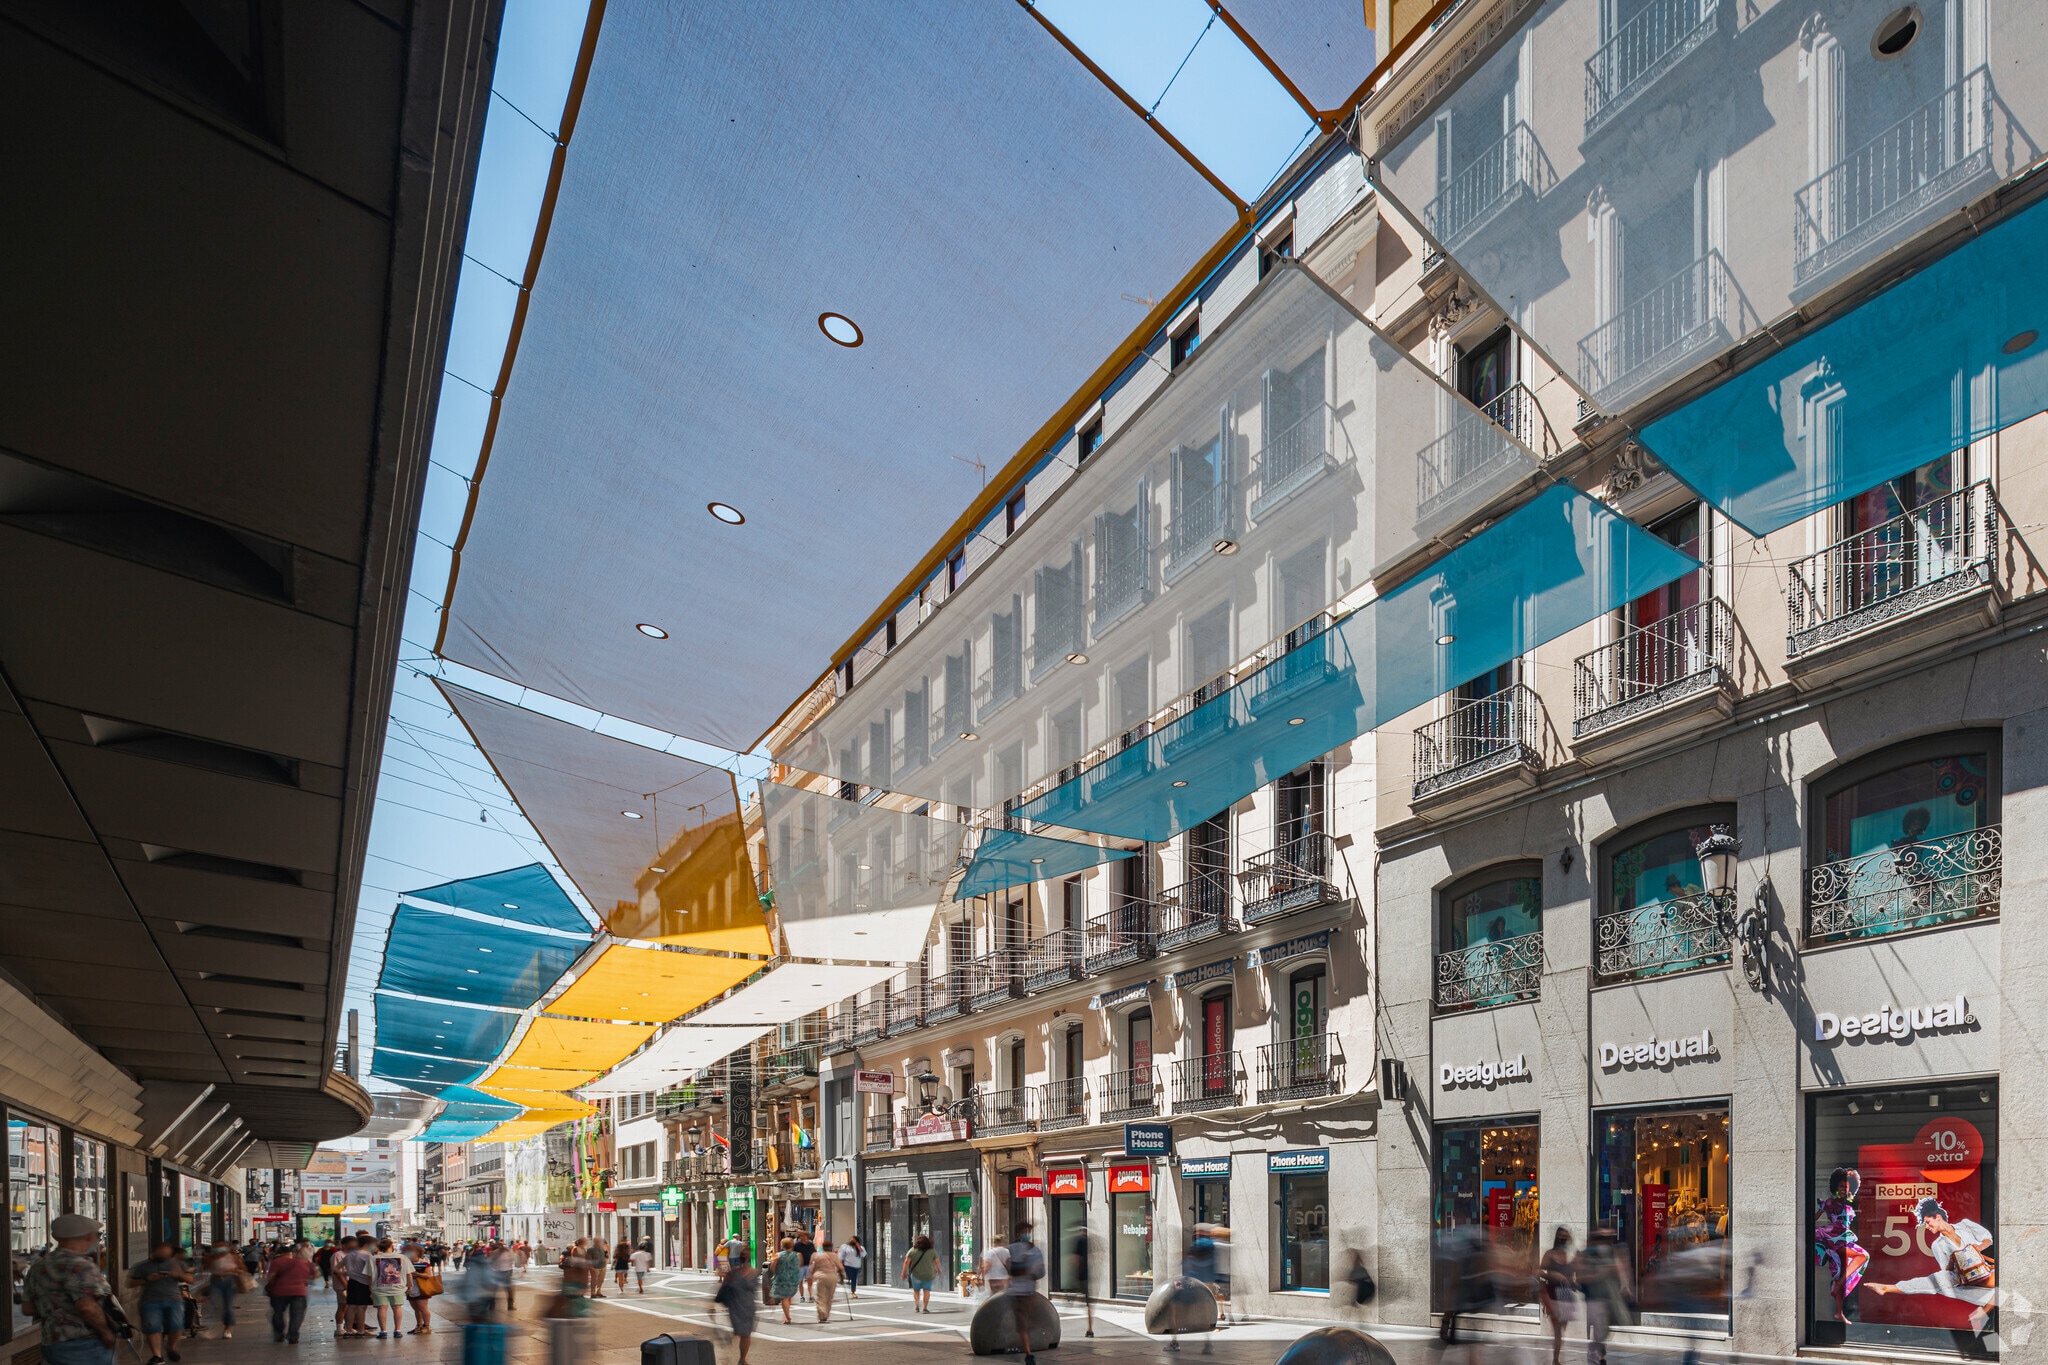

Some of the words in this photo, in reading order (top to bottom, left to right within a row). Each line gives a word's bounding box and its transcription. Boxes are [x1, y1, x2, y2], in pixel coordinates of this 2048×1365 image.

[1250, 946, 1287, 967] Phone
[1167, 971, 1197, 988] Phone
[1198, 962, 1231, 980] House
[1131, 1130, 1164, 1139] Phone
[1924, 1130, 1966, 1151] -10%
[1131, 1139, 1164, 1148] House
[1181, 1163, 1204, 1173] Phone
[1205, 1161, 1229, 1172] House
[1271, 1156, 1296, 1167] Phone
[1297, 1154, 1325, 1166] House
[1055, 1173, 1078, 1189] CAMPER
[1117, 1170, 1143, 1187] CAMPER
[1019, 1183, 1042, 1192] CAMPER
[1878, 1185, 1936, 1199] Rebajas.
[129, 1185, 147, 1233] fnac
[1123, 1224, 1148, 1237] Rebajas
